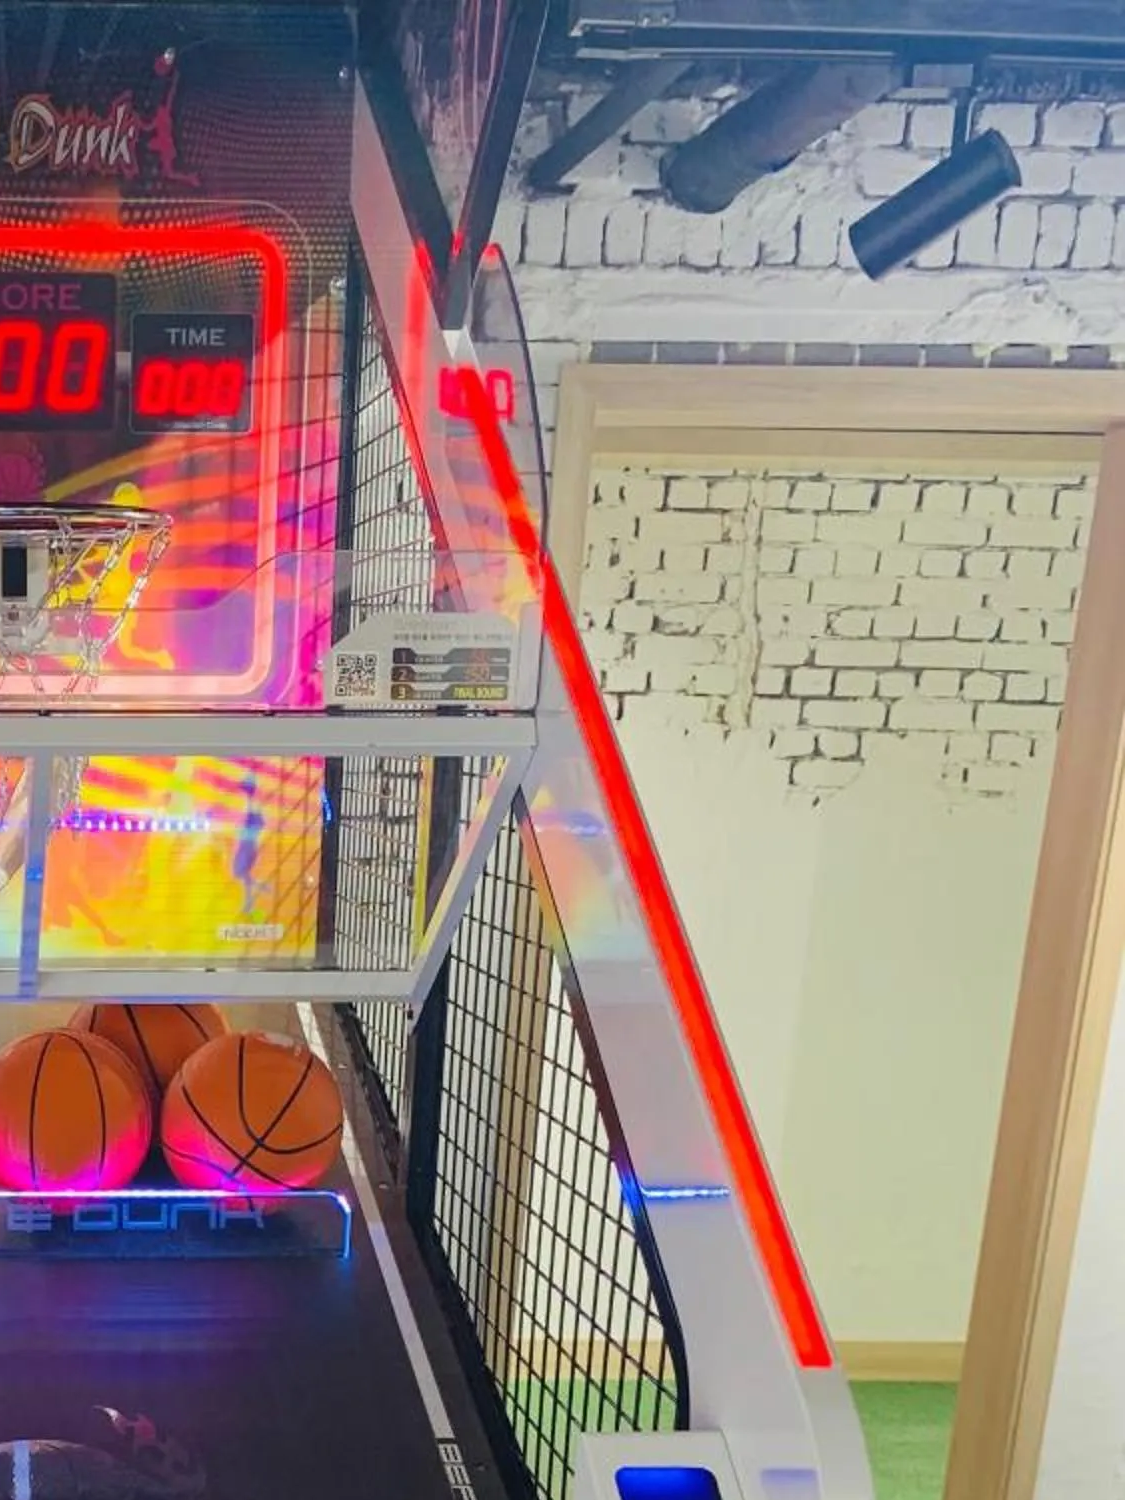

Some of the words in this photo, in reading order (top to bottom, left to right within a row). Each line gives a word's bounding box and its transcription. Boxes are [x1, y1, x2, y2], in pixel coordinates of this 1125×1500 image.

[10, 96, 138, 175] Dunk
[165, 327, 226, 347] TIME
[74, 1203, 265, 1231] DUNK
